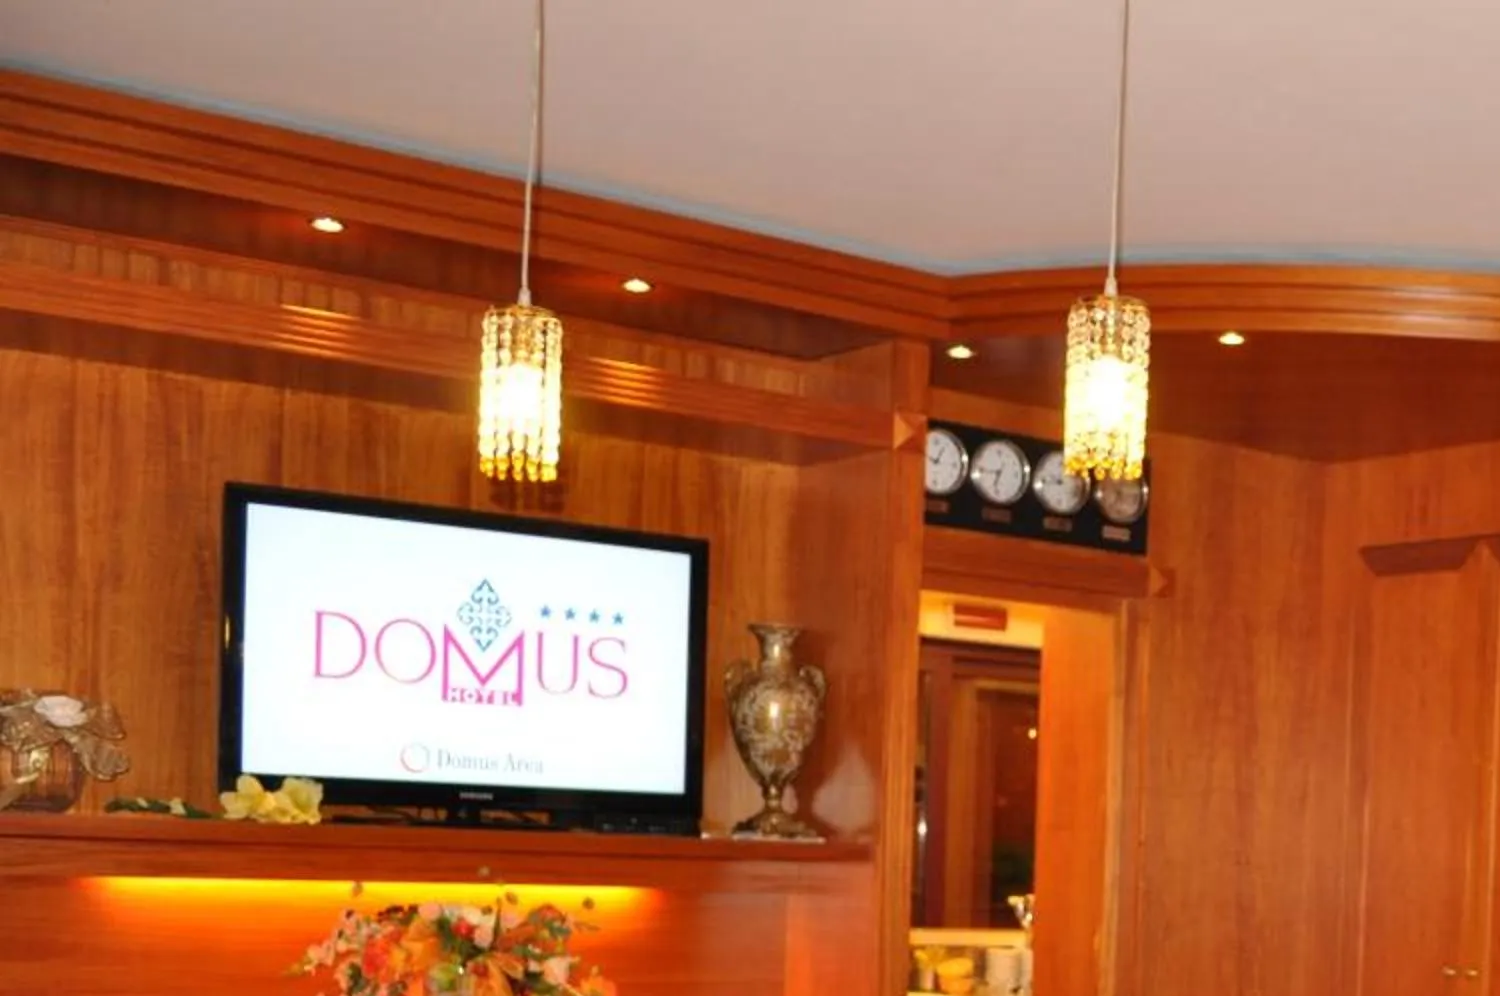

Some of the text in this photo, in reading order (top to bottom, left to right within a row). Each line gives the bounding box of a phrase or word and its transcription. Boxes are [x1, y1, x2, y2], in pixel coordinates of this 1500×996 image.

[313, 610, 630, 707] DOMUS
[437, 748, 545, 774] Domus Area
